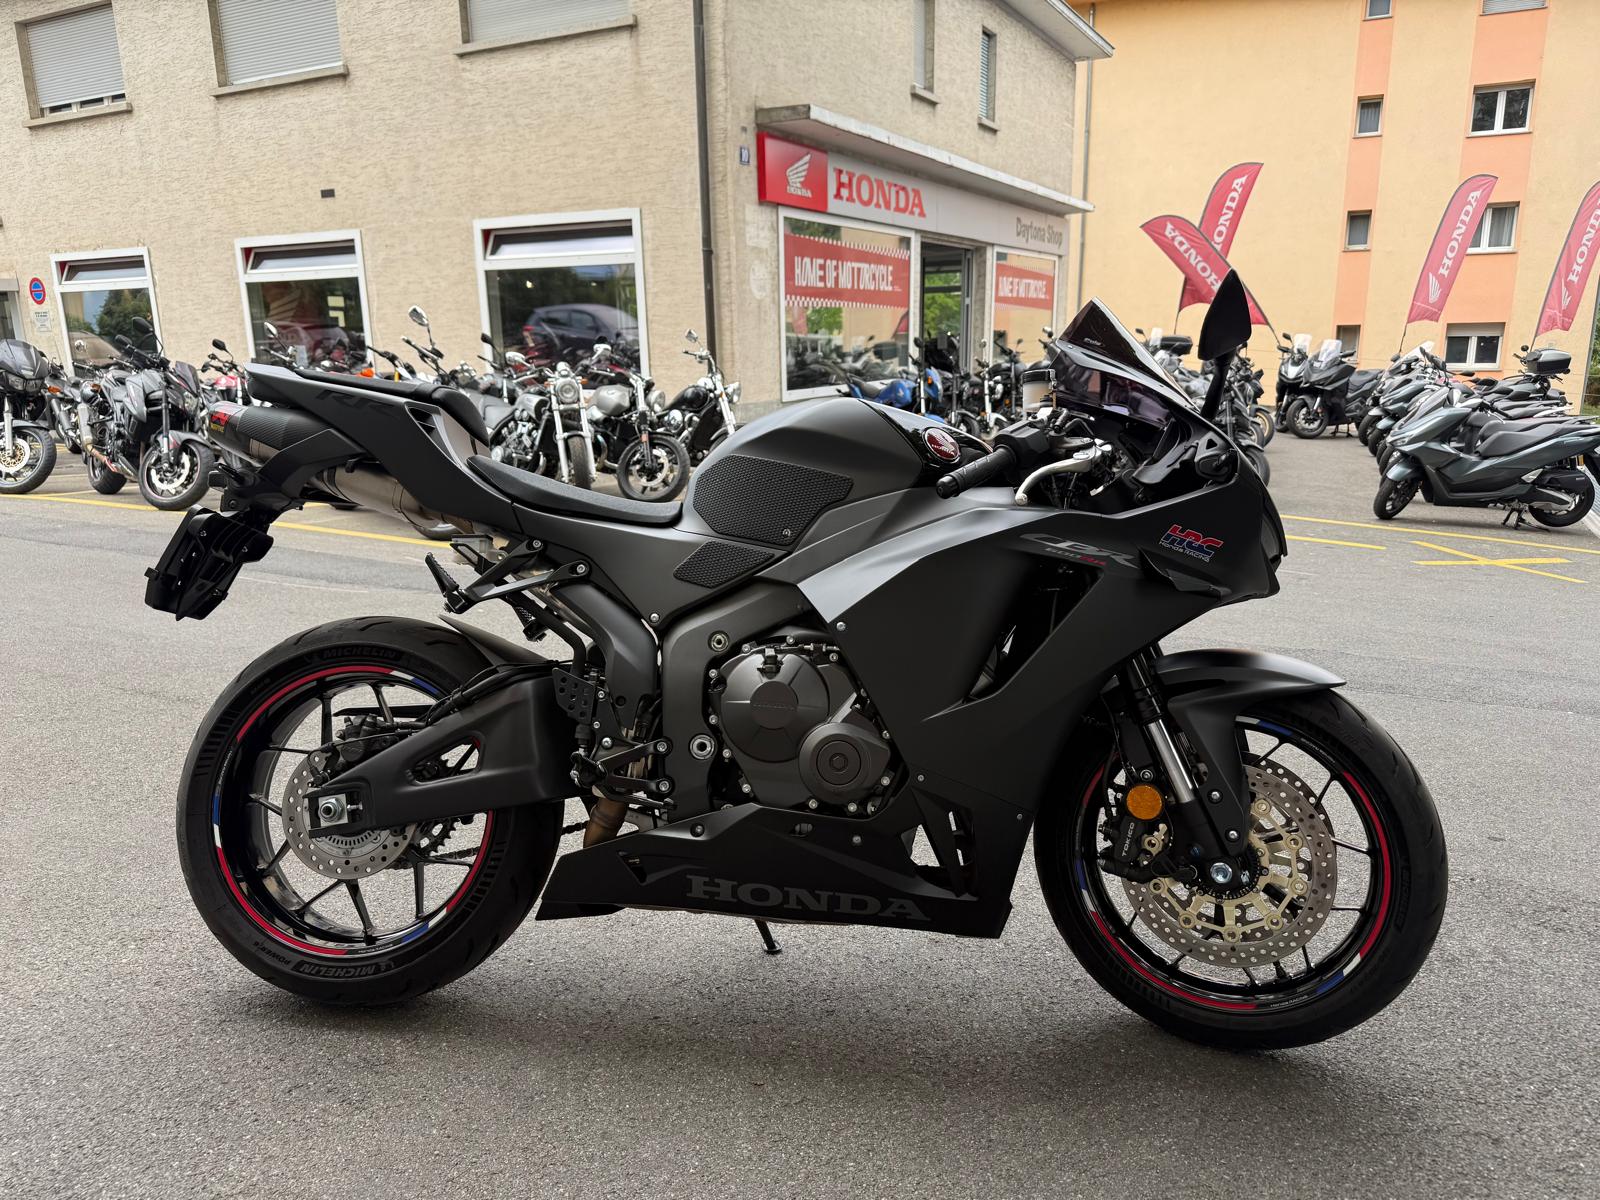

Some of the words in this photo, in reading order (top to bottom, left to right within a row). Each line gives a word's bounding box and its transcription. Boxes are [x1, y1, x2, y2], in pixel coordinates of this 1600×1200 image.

[832, 167, 927, 218] HONDA
[1016, 216, 1046, 244] Daytona
[1046, 224, 1063, 249] Shop
[1438, 189, 1482, 278] HONDA
[1567, 197, 1600, 284] HOND
[826, 259, 837, 289] OF
[1161, 524, 1224, 557] HRC
[1184, 549, 1210, 563] RACING
[322, 646, 399, 660] MICHELIN
[1121, 822, 1135, 857] TOKICO
[685, 874, 932, 921] HONDA
[299, 961, 376, 978] MICHELIN
